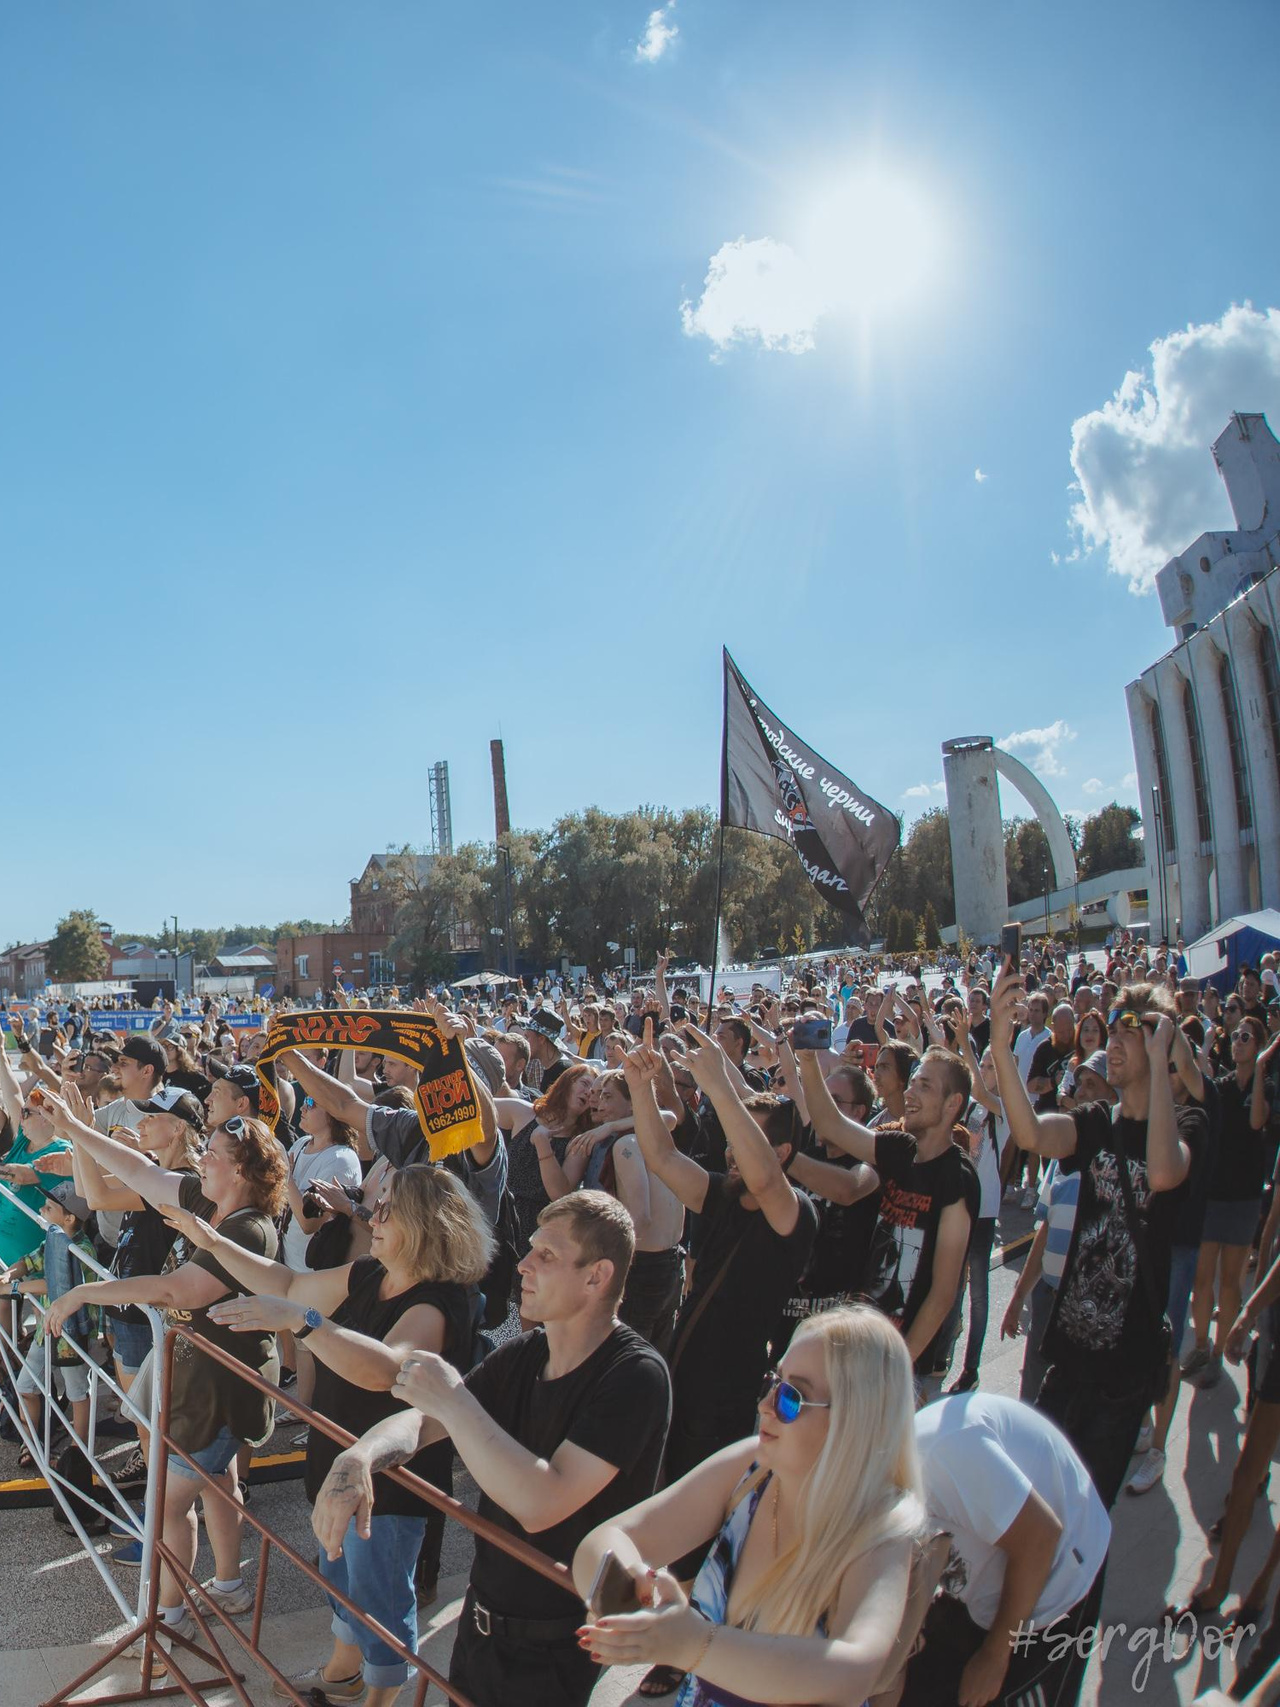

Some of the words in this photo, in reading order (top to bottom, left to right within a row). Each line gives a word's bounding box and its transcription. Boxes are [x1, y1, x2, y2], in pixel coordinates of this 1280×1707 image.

[819, 776, 875, 827] черти
[292, 1015, 381, 1043] КИНО
[419, 1068, 465, 1096] ВИКТОР
[422, 1080, 471, 1115] ЦОЙ
[428, 1104, 475, 1131] 1962-1990
